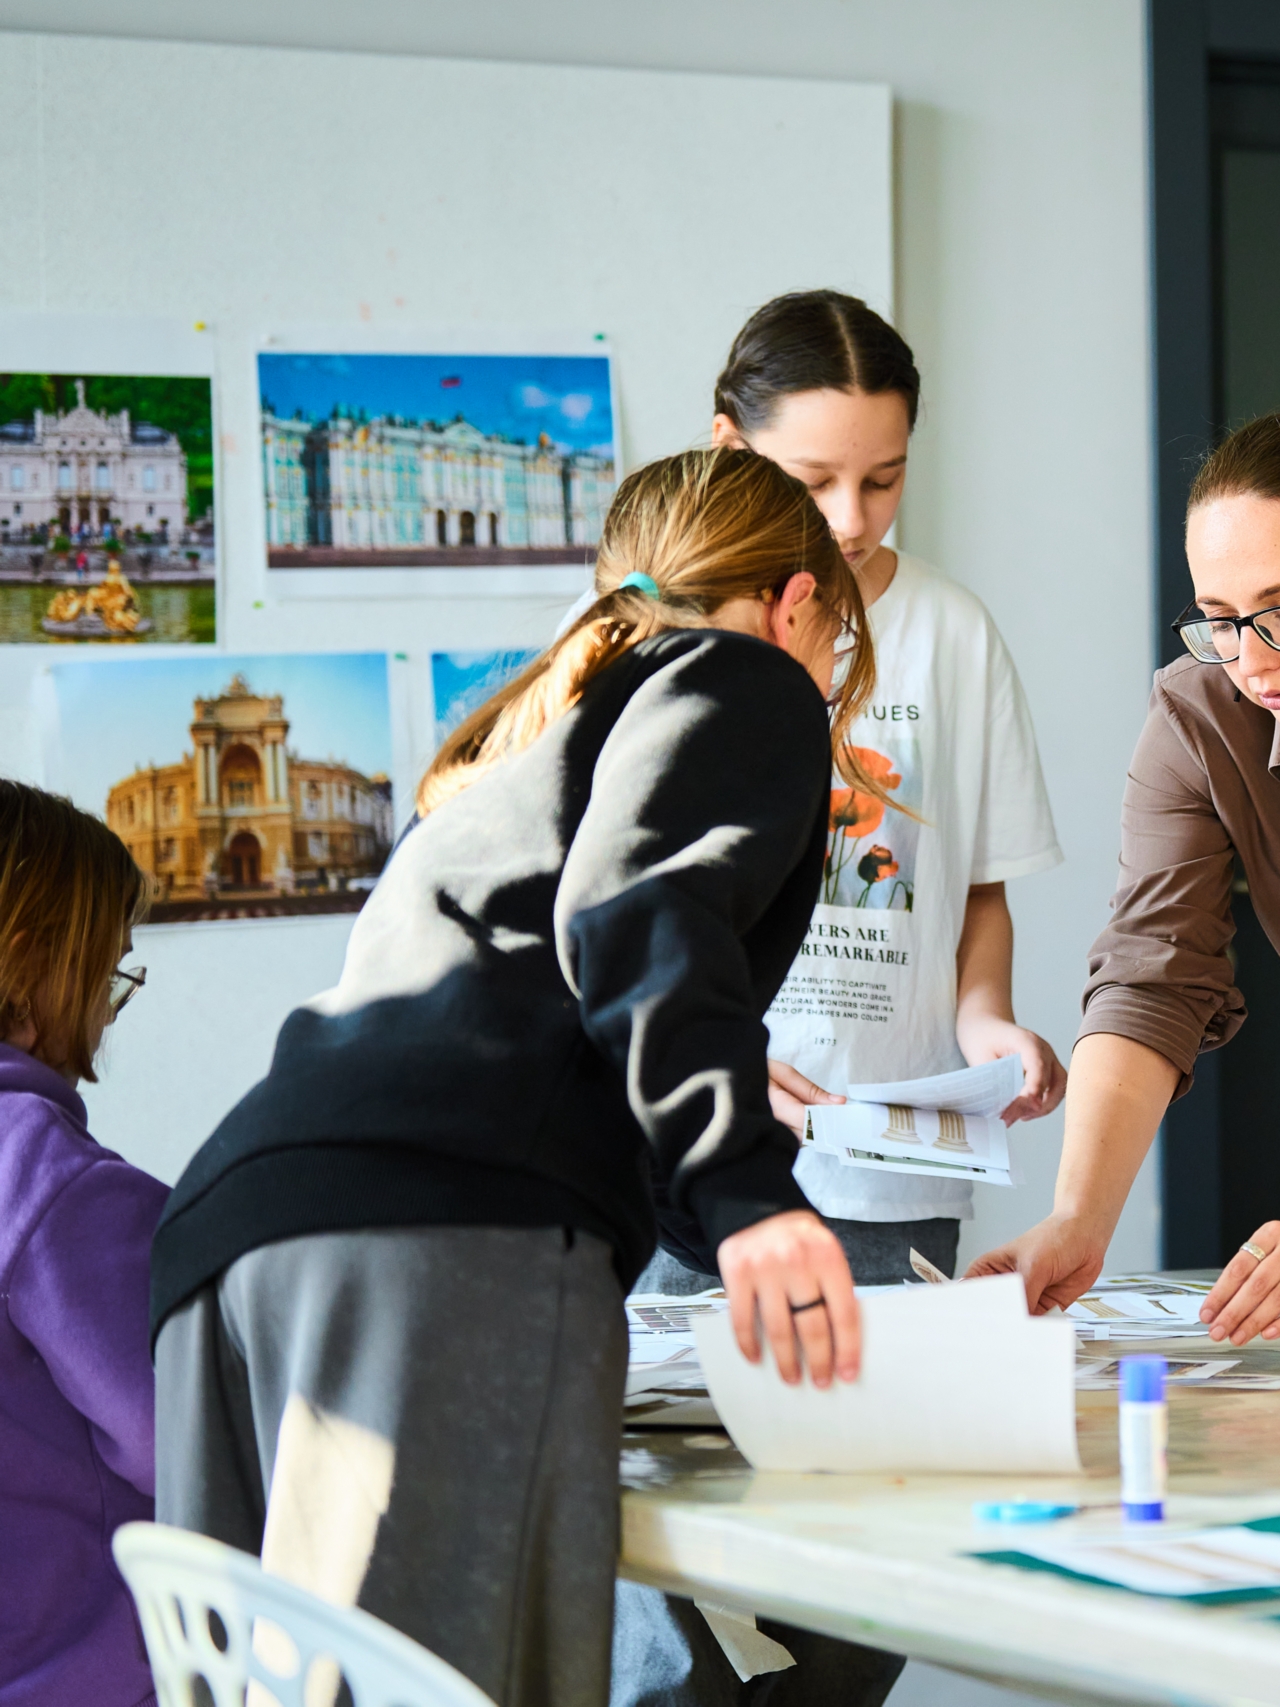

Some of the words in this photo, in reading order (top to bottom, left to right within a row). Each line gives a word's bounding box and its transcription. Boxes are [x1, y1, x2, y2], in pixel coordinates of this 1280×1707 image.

[855, 927, 890, 943] ARE
[801, 943, 909, 965] REMARKABLE
[801, 976, 834, 985] ABILITY
[836, 979, 847, 987] TO
[848, 980, 887, 992] CAPTIVATE
[789, 986, 816, 995] THEIR
[818, 988, 849, 997] BEAUTY
[870, 994, 892, 1003] GRACE
[817, 998, 858, 1009] WONDERS
[860, 1003, 879, 1012] COME
[790, 1007, 803, 1015] OF
[806, 1008, 841, 1018] SHAPES
[842, 1010, 859, 1019] AND
[860, 1013, 888, 1023] COLORS
